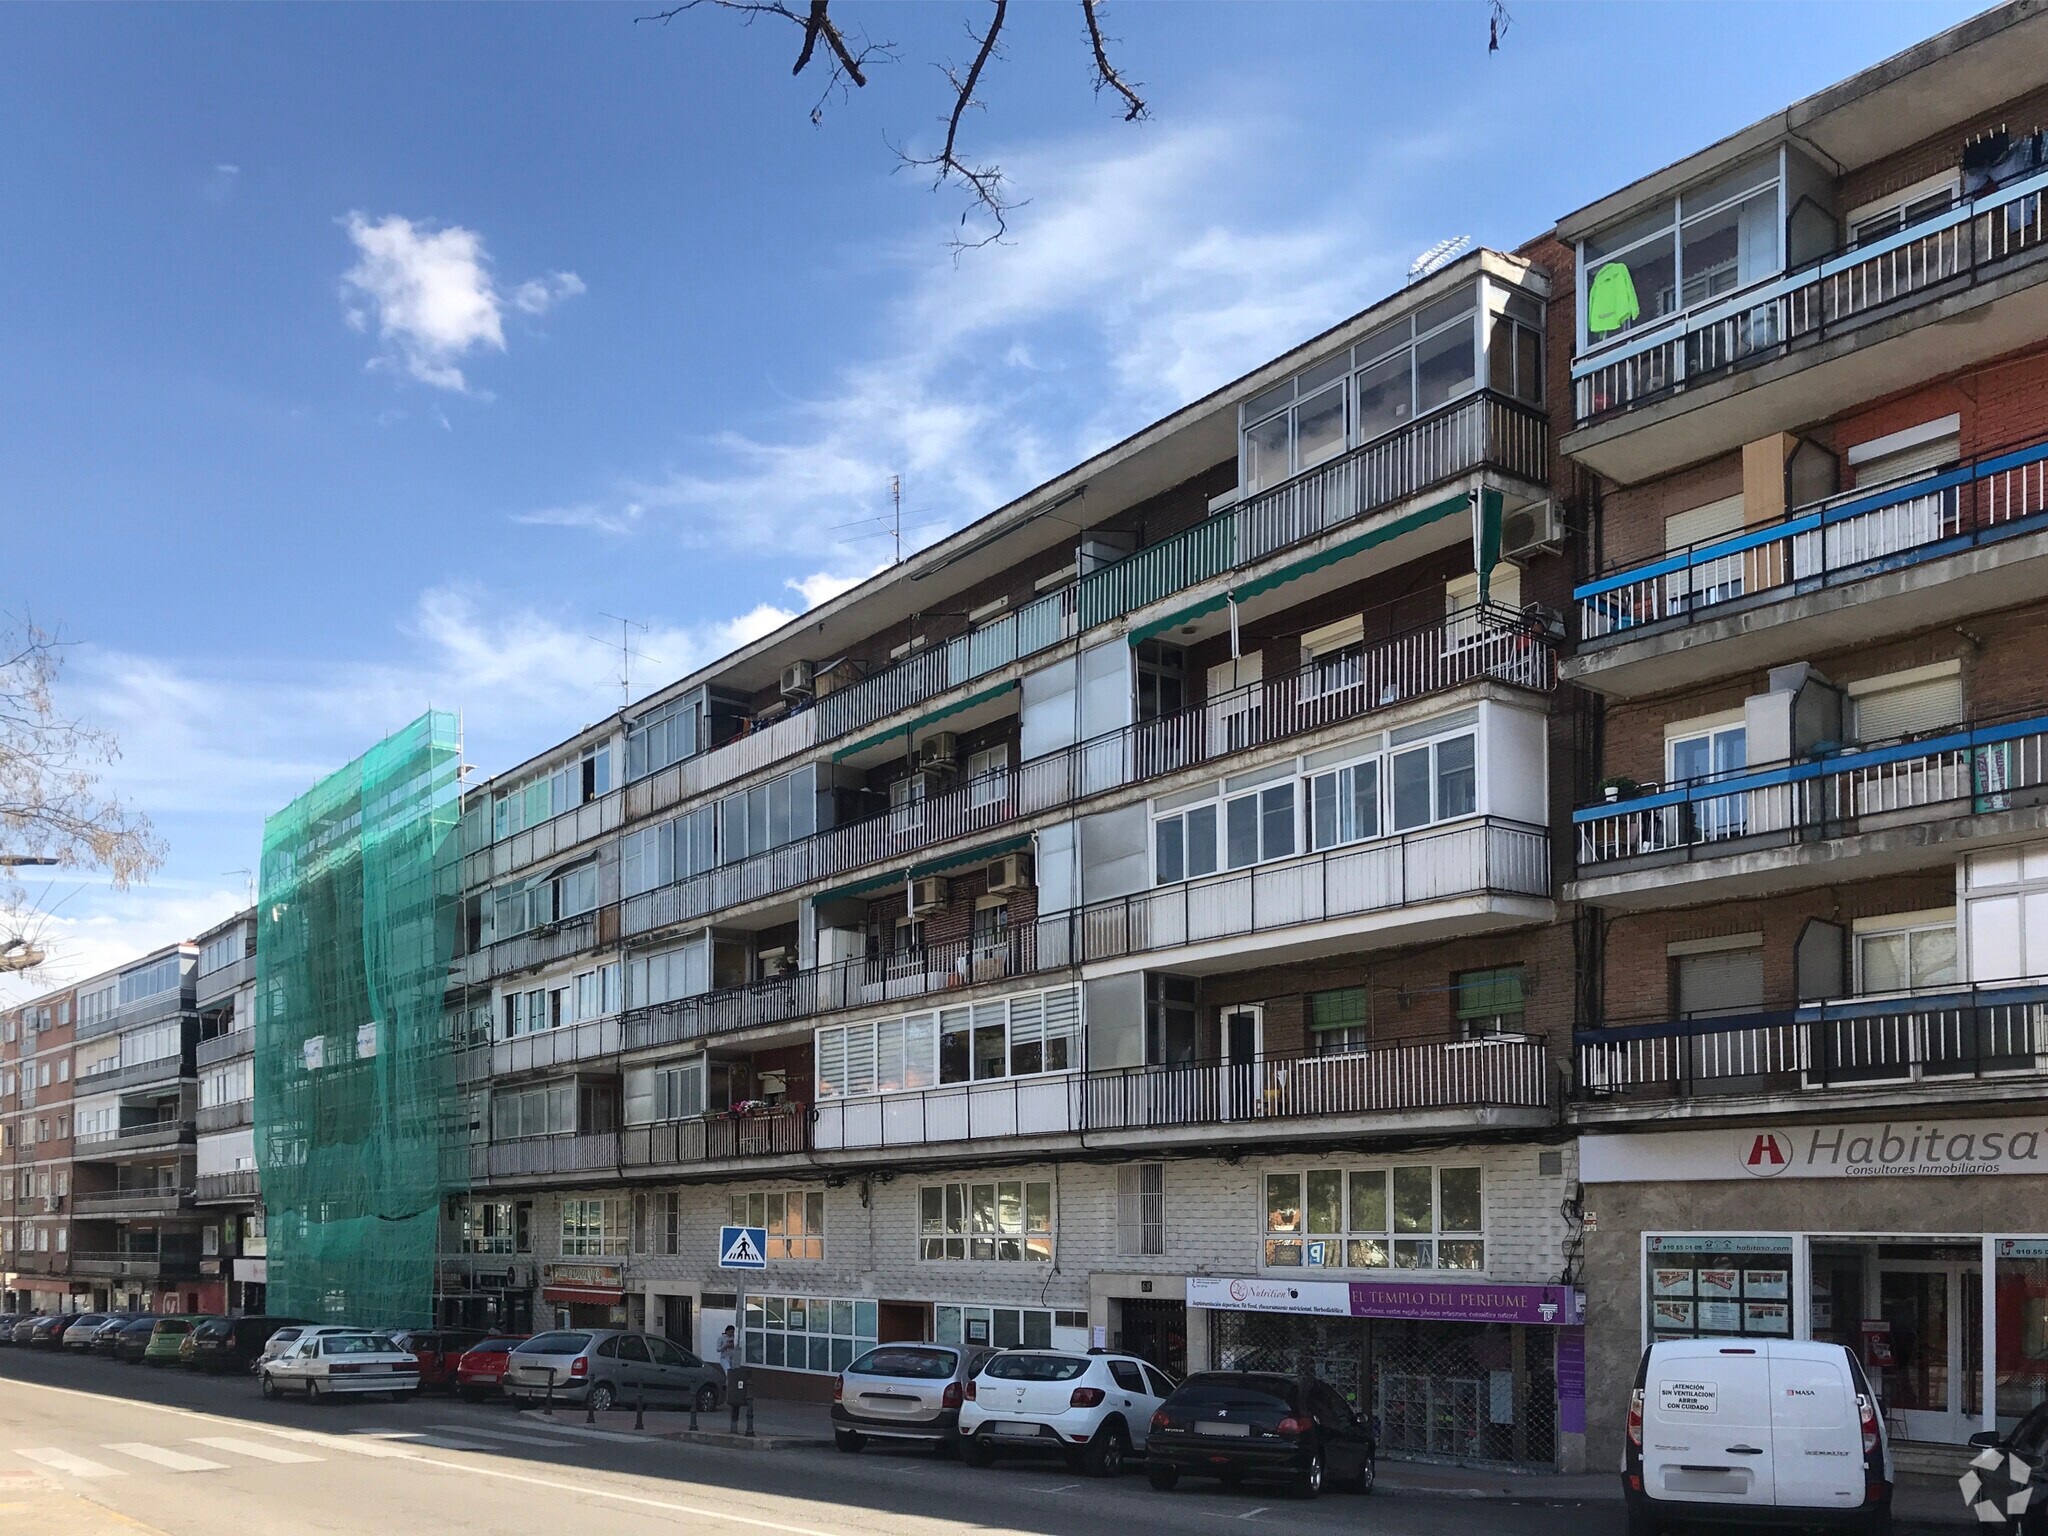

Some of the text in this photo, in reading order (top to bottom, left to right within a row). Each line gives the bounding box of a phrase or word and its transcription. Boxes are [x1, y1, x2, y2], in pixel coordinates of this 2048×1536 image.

[1807, 1124, 2040, 1164] Habitasa
[1845, 1162, 2000, 1175] Consultores Inmobiliarios
[1352, 1290, 1528, 1308] EL TEMPLO DEL PERFUME
